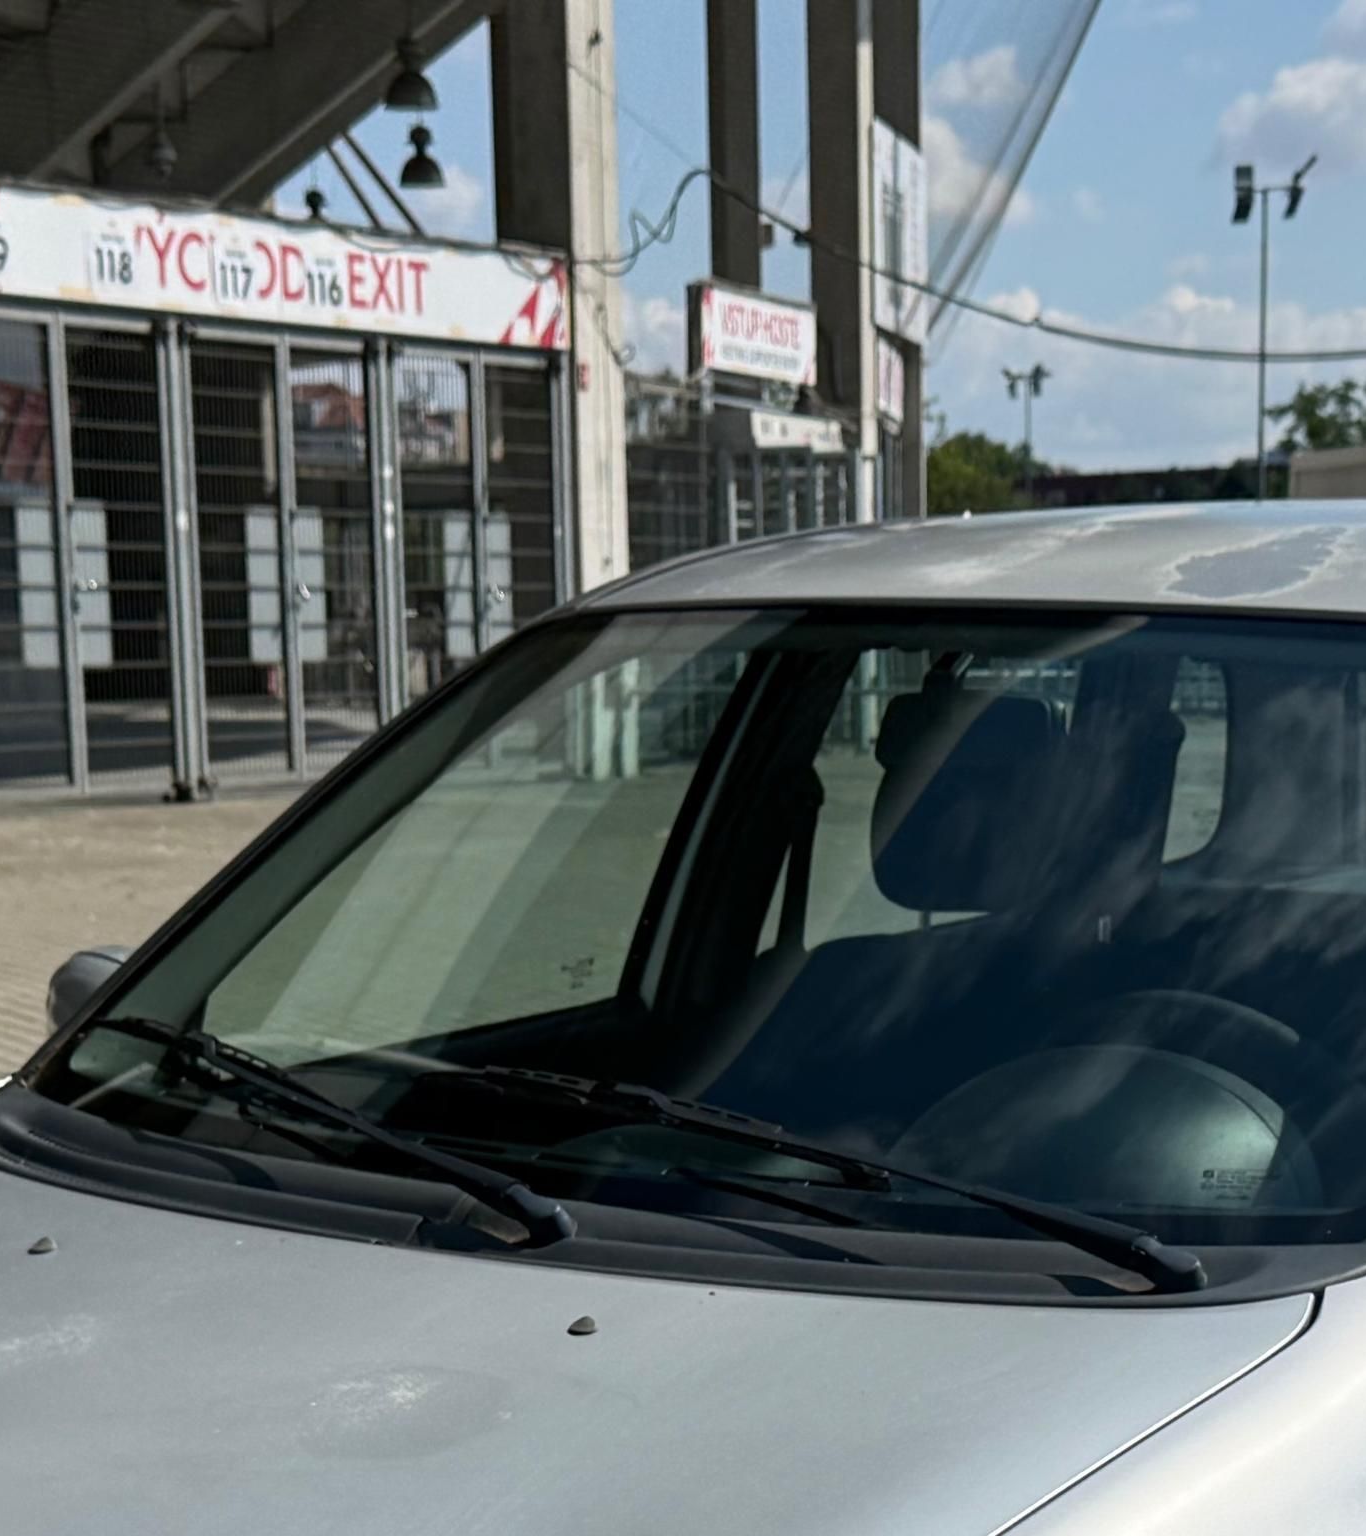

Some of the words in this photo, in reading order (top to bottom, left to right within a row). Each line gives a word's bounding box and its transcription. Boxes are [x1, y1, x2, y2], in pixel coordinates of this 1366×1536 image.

[95, 246, 133, 285] 118
[220, 261, 253, 299] 117
[348, 250, 428, 316] EXIT
[307, 271, 343, 307] 116
